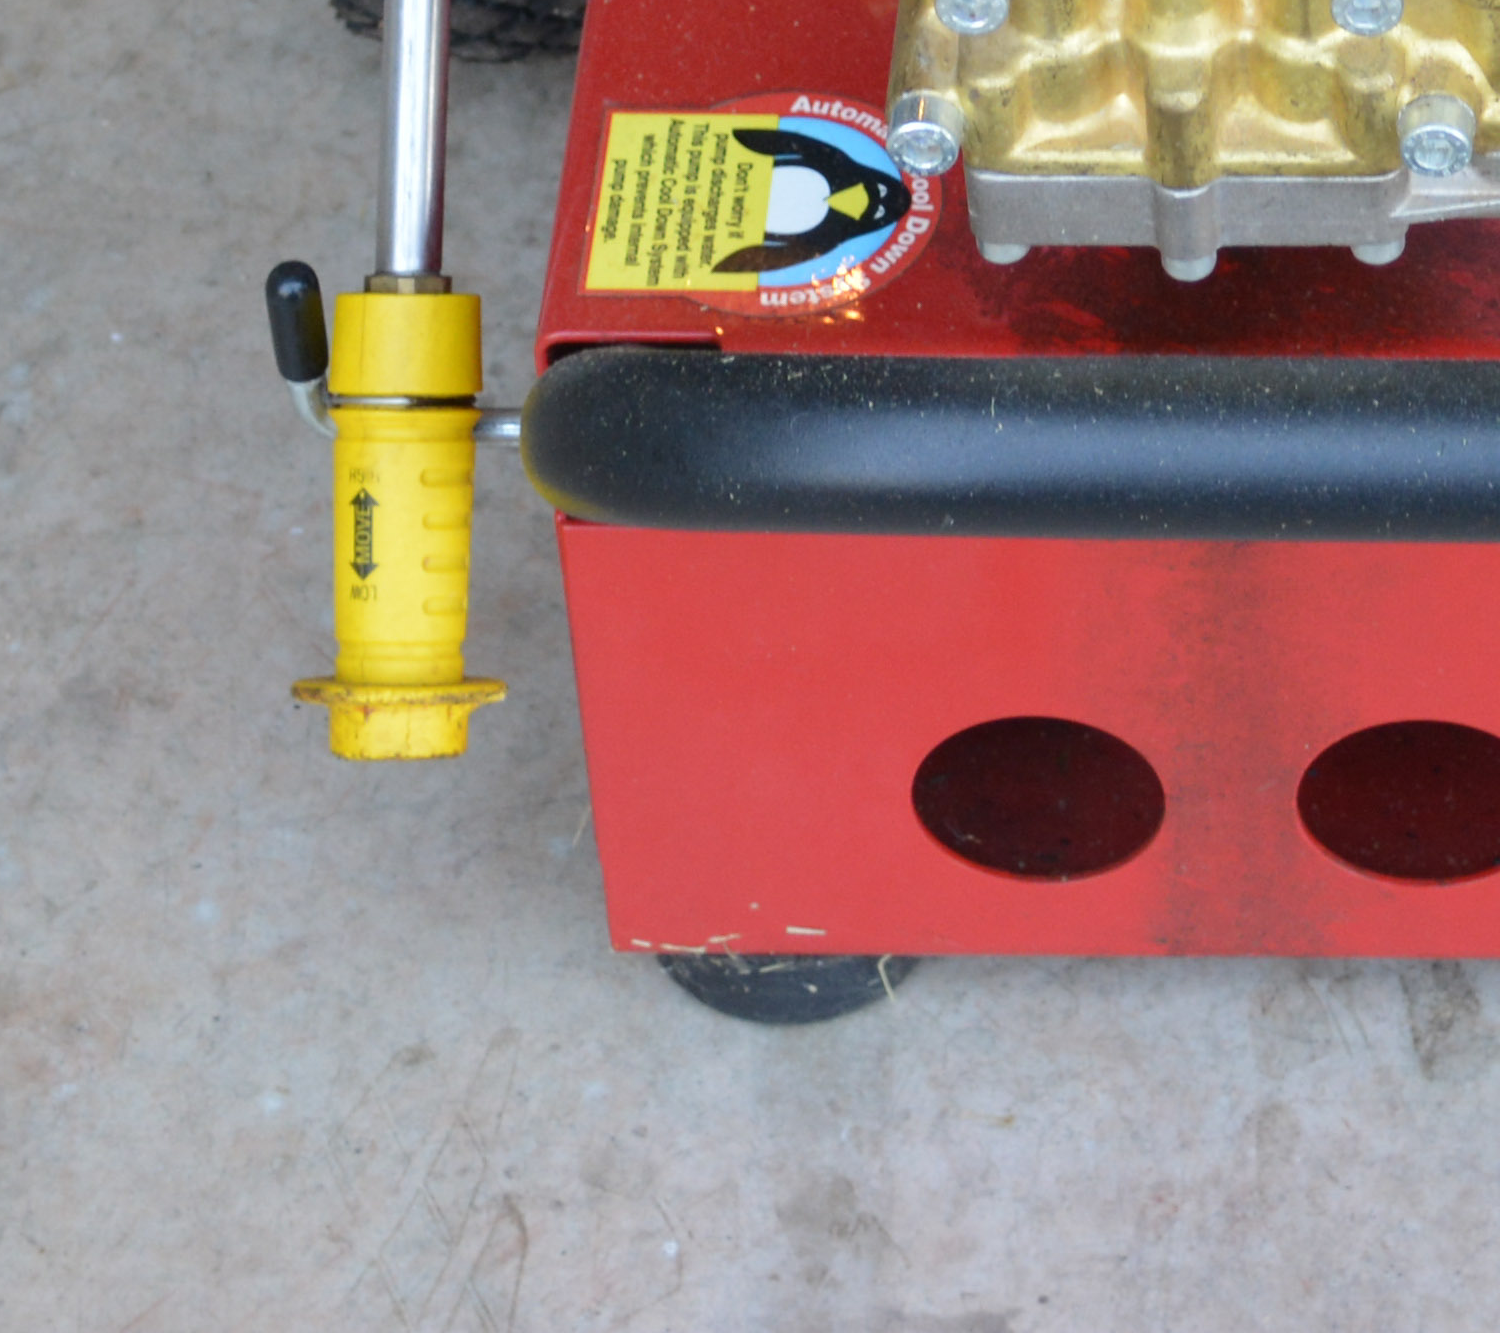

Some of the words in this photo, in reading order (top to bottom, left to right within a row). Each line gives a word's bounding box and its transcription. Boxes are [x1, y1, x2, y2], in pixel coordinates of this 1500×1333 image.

[691, 122, 710, 147] This
[790, 95, 888, 140] Automa
[640, 134, 657, 167] which
[662, 118, 685, 175] Automatic
[684, 150, 702, 182] pump
[710, 133, 729, 165] pump
[609, 158, 627, 191] pump
[632, 170, 649, 219] prevents
[658, 178, 678, 204] Cool
[911, 174, 934, 212] ool
[702, 168, 726, 231] discharges
[653, 207, 673, 241] Down
[675, 198, 696, 251] equipped
[870, 215, 931, 274] Down
[646, 244, 668, 286] System
[354, 502, 371, 564] MOVE
